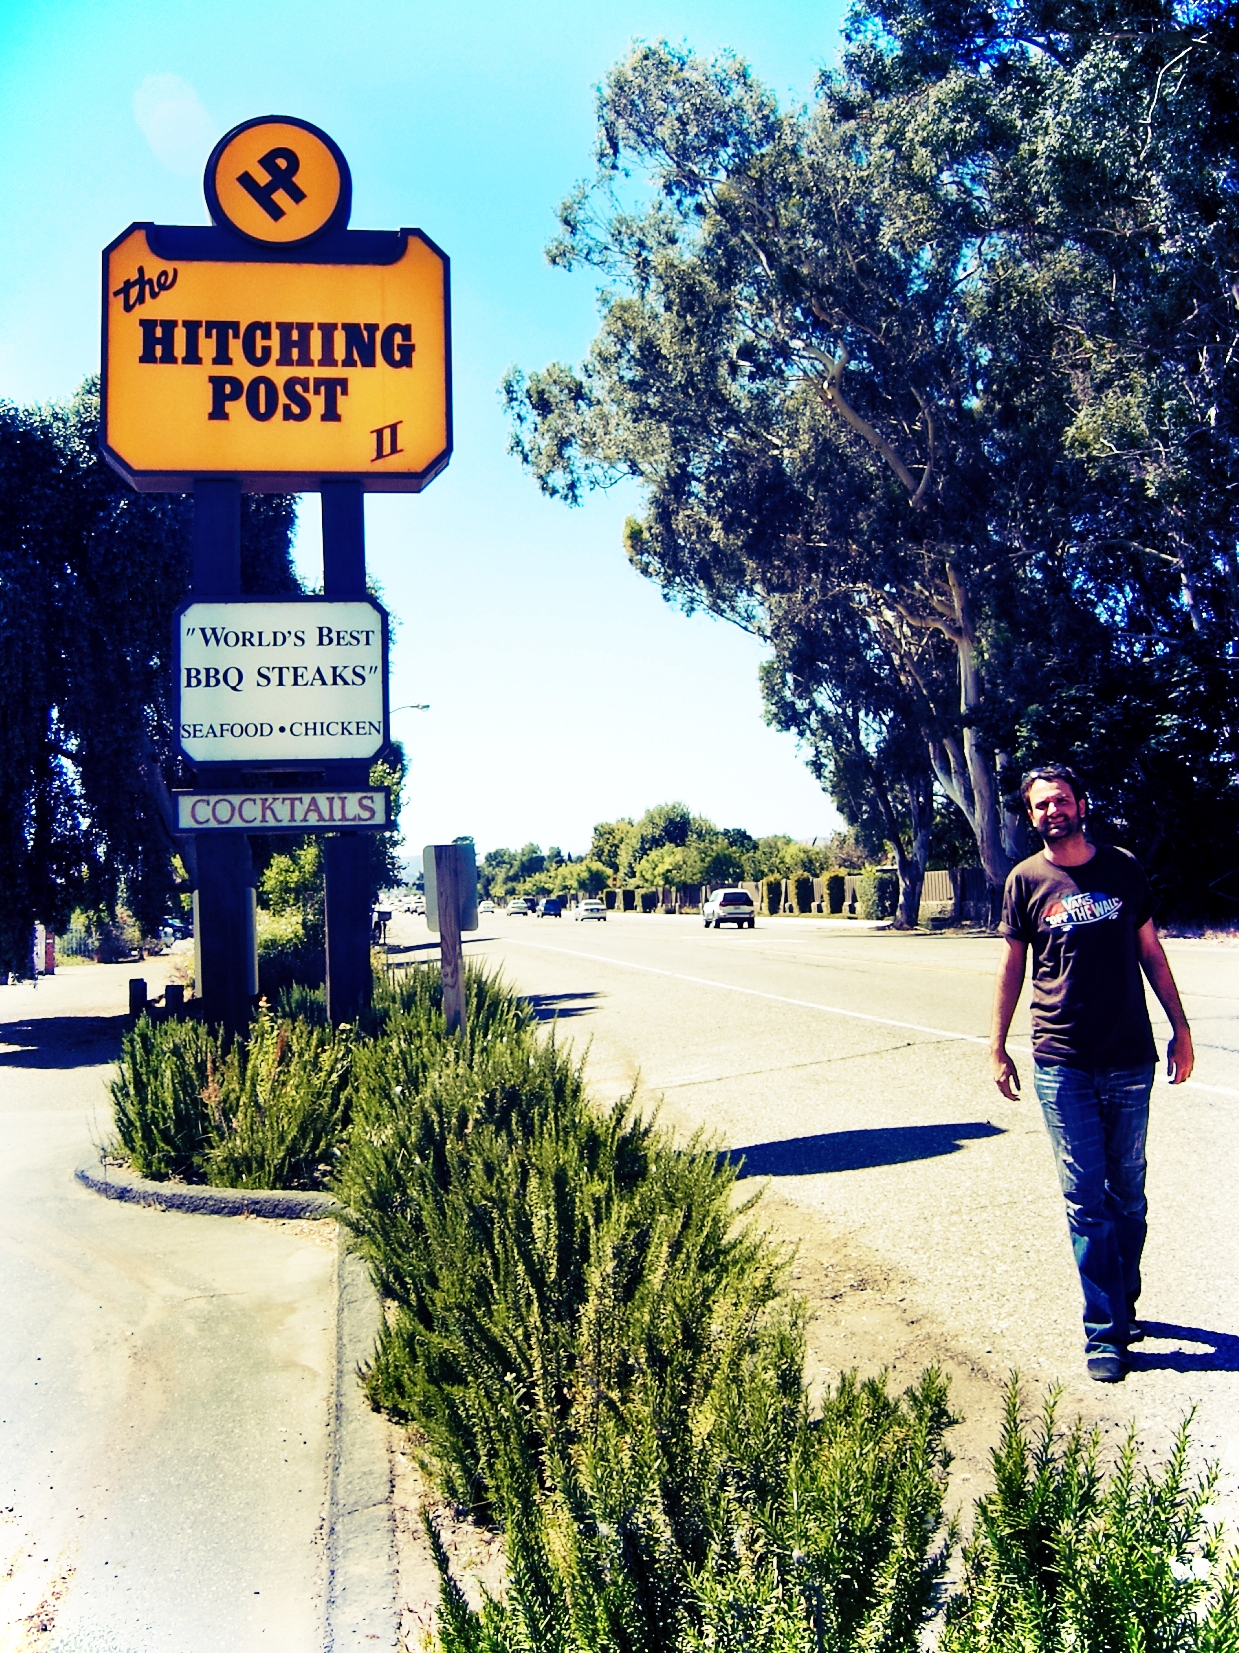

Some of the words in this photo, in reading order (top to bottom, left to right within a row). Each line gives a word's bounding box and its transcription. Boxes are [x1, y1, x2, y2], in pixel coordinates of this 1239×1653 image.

[113, 265, 178, 313] the
[138, 318, 416, 369] HITCHING
[208, 374, 349, 422] POST
[370, 420, 404, 462] II
[184, 666, 244, 692] BBQ
[190, 795, 376, 825] COCKTAILS
[1062, 893, 1093, 910] VANS
[1070, 905, 1094, 922] THE
